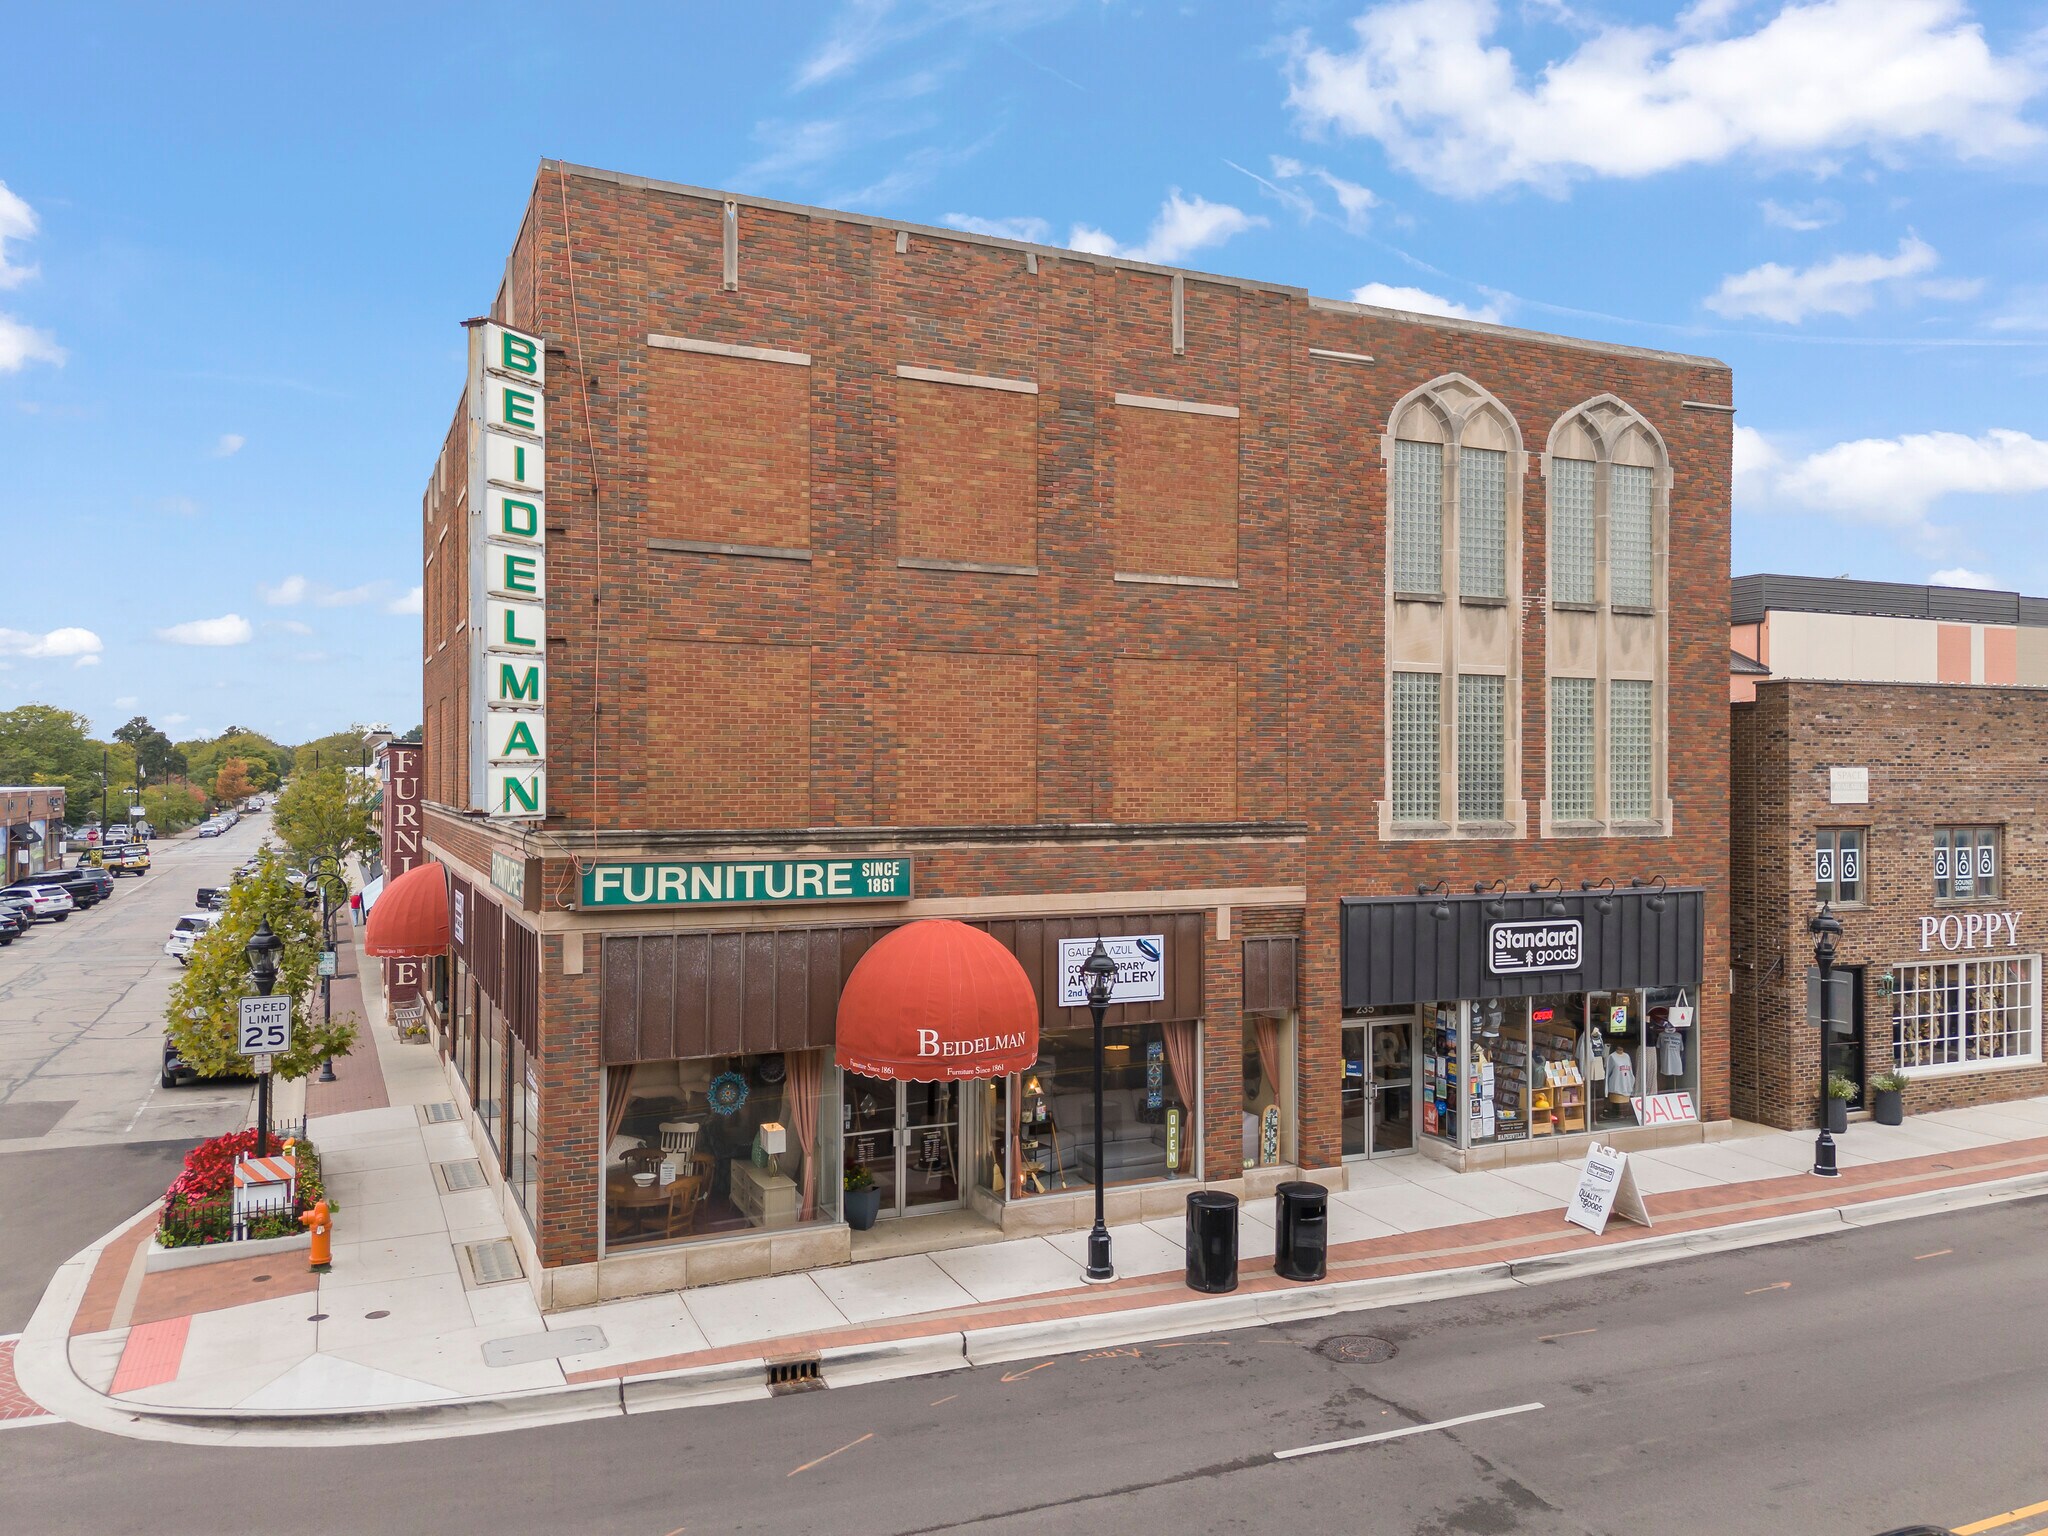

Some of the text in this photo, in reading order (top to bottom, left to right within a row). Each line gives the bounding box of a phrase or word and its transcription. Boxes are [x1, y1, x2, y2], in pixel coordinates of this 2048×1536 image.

[501, 331, 540, 813] BEIDELMAN
[394, 750, 420, 986] FURNIE
[862, 862, 899, 877] SINCE
[594, 863, 853, 901] FURNITURE
[867, 878, 894, 893] 1861
[1495, 926, 1577, 949] Standard
[1919, 912, 2023, 951] POPPY
[1109, 946, 1132, 955] AZUL
[1536, 946, 1577, 965] goods
[1068, 989, 1082, 997] 2nd
[244, 1003, 286, 1013] SPEED
[1533, 1010, 1553, 1021] OPEN
[249, 1014, 281, 1024] LIMIT
[245, 1025, 285, 1047] 25
[917, 1029, 1026, 1057] BEIDELMAN
[867, 1063, 880, 1072] Since
[881, 1066, 894, 1075] 1861
[947, 1064, 1004, 1076] Furniture Since 1861
[1635, 1094, 1695, 1123] SALE
[1590, 1162, 1613, 1176] Standard
[1578, 1188, 1602, 1203] QUALITY
